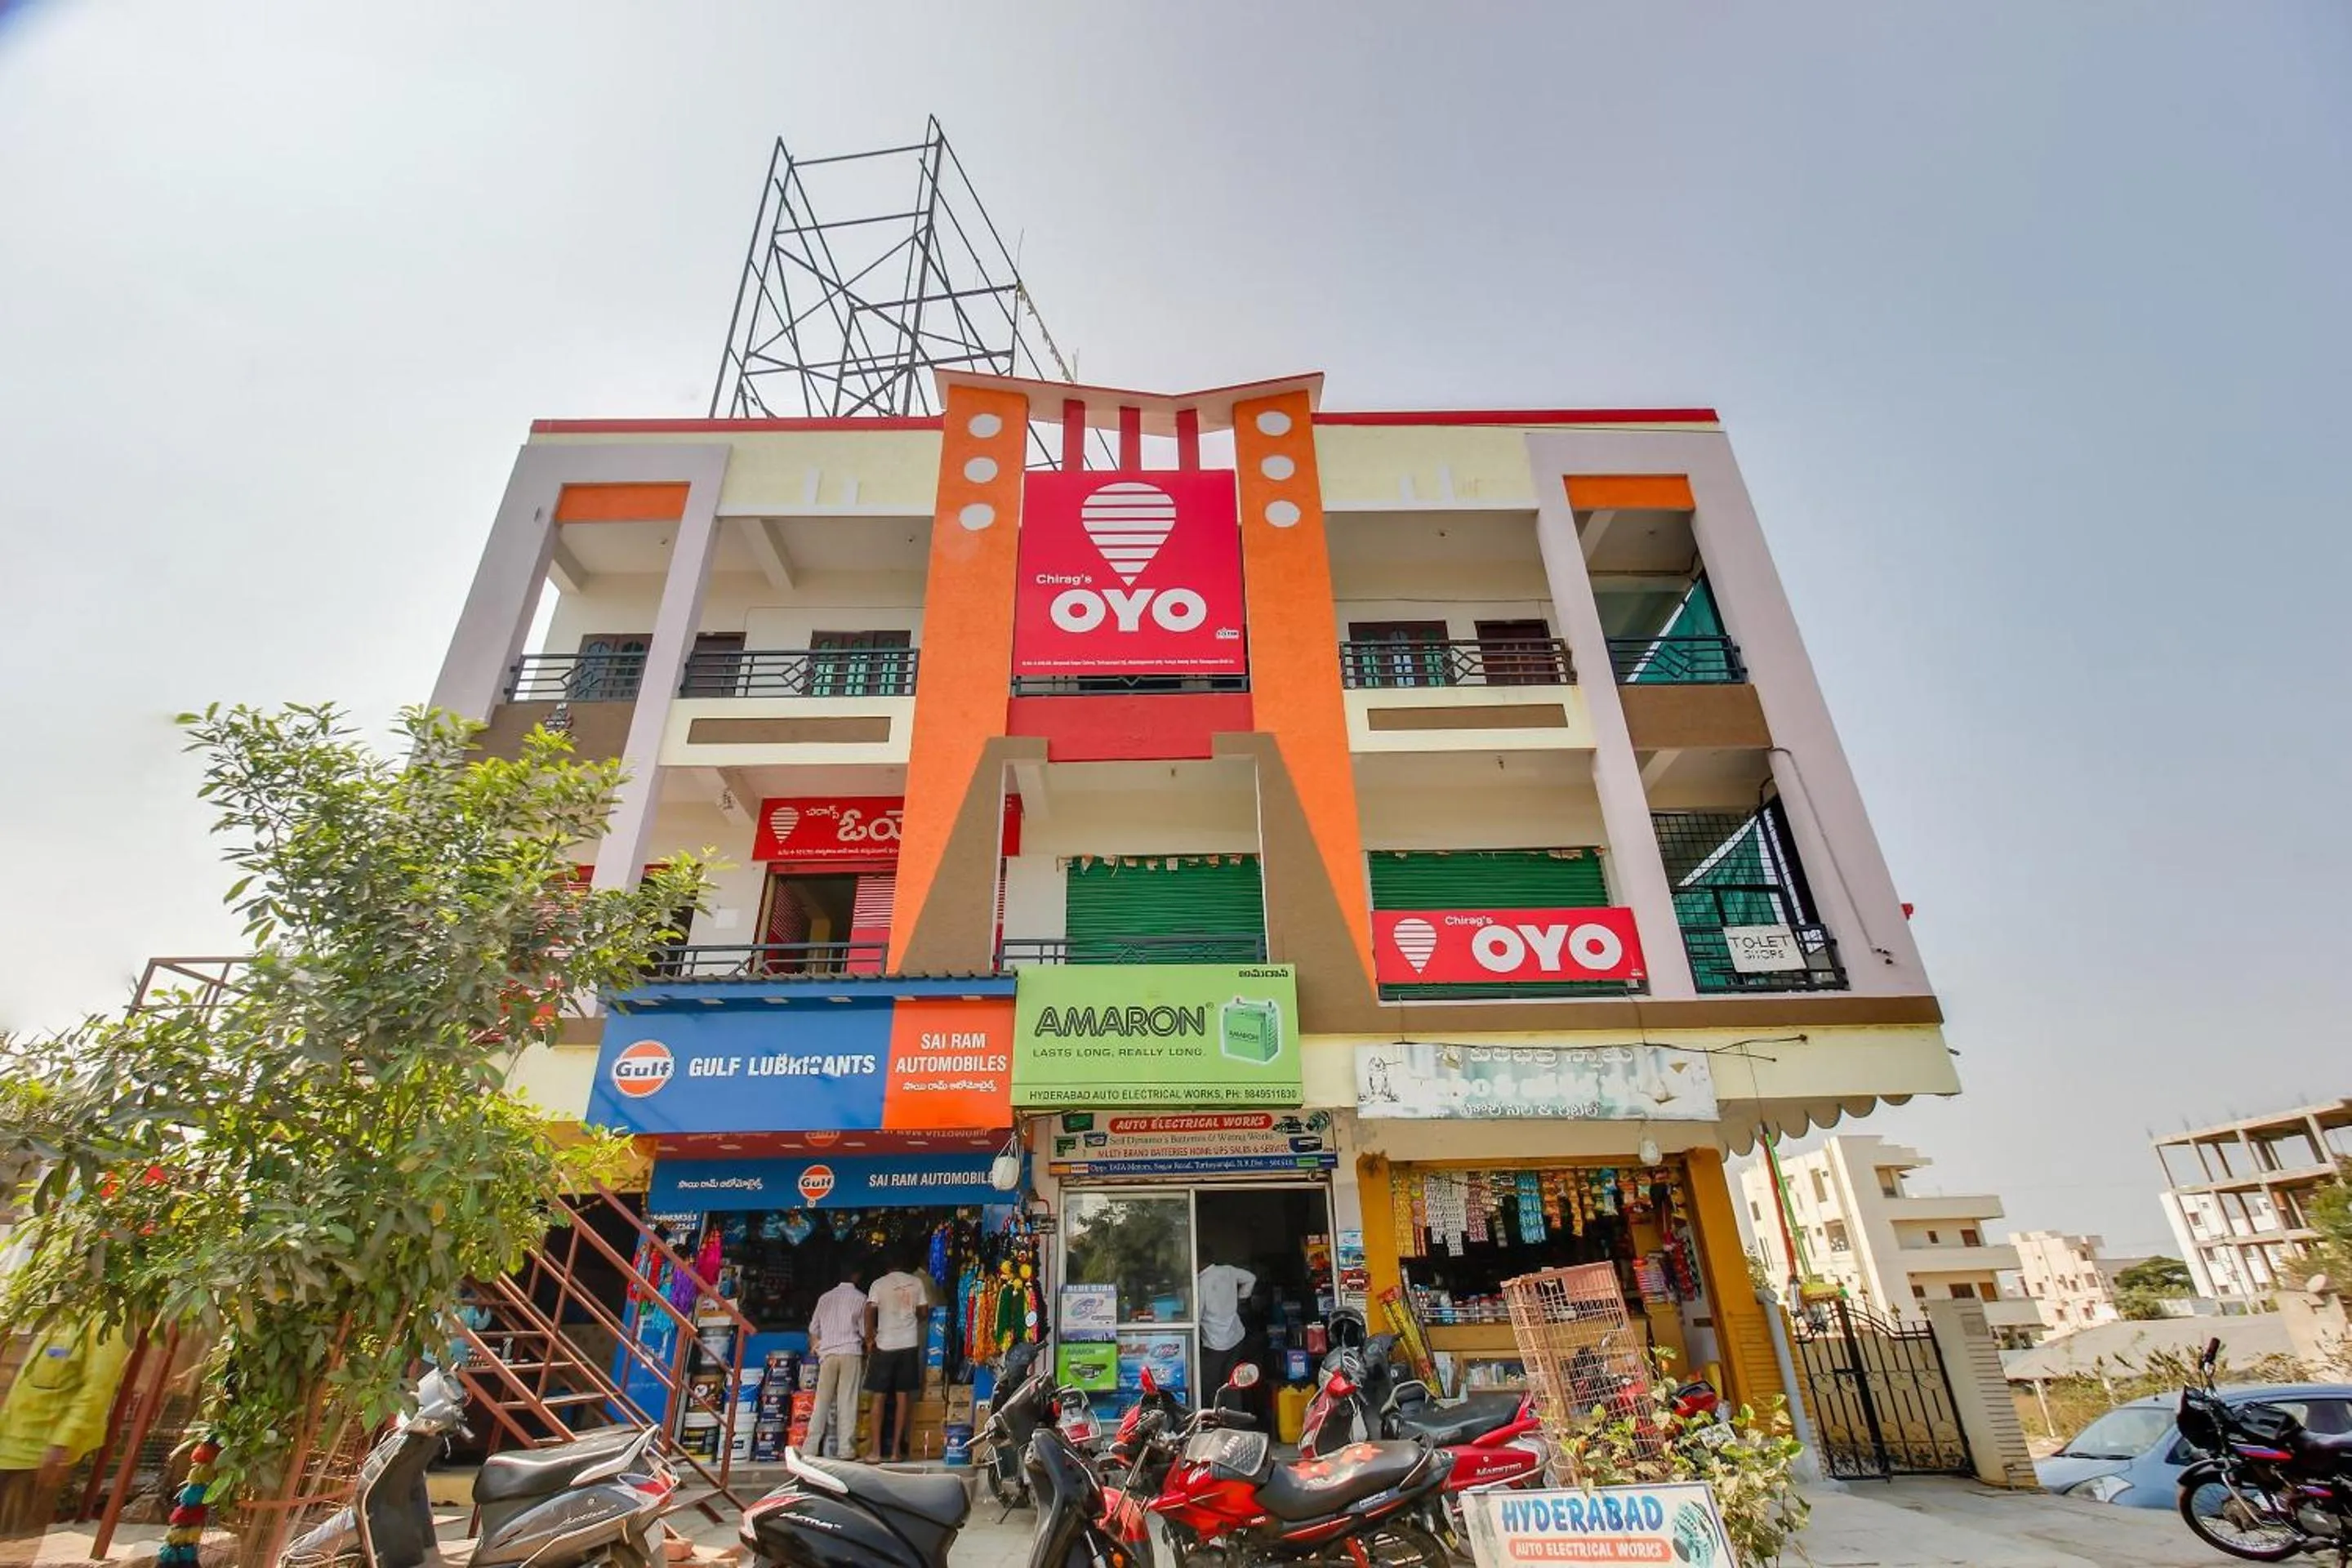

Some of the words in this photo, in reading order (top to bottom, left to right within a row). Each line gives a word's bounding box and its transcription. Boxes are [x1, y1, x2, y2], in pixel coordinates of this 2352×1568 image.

[1036, 574, 1092, 585] Chirag's
[1050, 588, 1207, 632] OYO
[1445, 915, 1494, 926] Chirag's
[1472, 923, 1623, 973] OYO
[1034, 1006, 1205, 1037] AMARON
[921, 1033, 947, 1049] SAI
[951, 1033, 986, 1049] RAM
[1033, 1048, 1072, 1058] LASTS
[1119, 1048, 1163, 1058] REALLY
[614, 1057, 675, 1078] Gulf
[688, 1057, 742, 1077] GULF
[896, 1055, 1007, 1073] AUTOMOBILES
[1030, 1090, 1090, 1100] HYDERABAD
[1093, 1090, 1119, 1100] AUTO
[1122, 1089, 1182, 1099] ELECTRICAL
[1116, 1120, 1147, 1130] AUTO
[1151, 1117, 1218, 1129] ELECTRICAL
[1223, 1116, 1266, 1127] WORKS
[800, 1176, 832, 1189] Gulf
[869, 1173, 888, 1187] SAI
[892, 1173, 919, 1187] RAM
[920, 1171, 994, 1185] AUTOMOBILE
[1067, 1284, 1089, 1292] BLUE
[1090, 1283, 1115, 1292] STAR
[1501, 1494, 1664, 1533] HYDERABAD
[1516, 1542, 1543, 1557] AUTO
[1546, 1541, 1613, 1557] ELECTRICAL
[1615, 1540, 1663, 1557] WORKS
